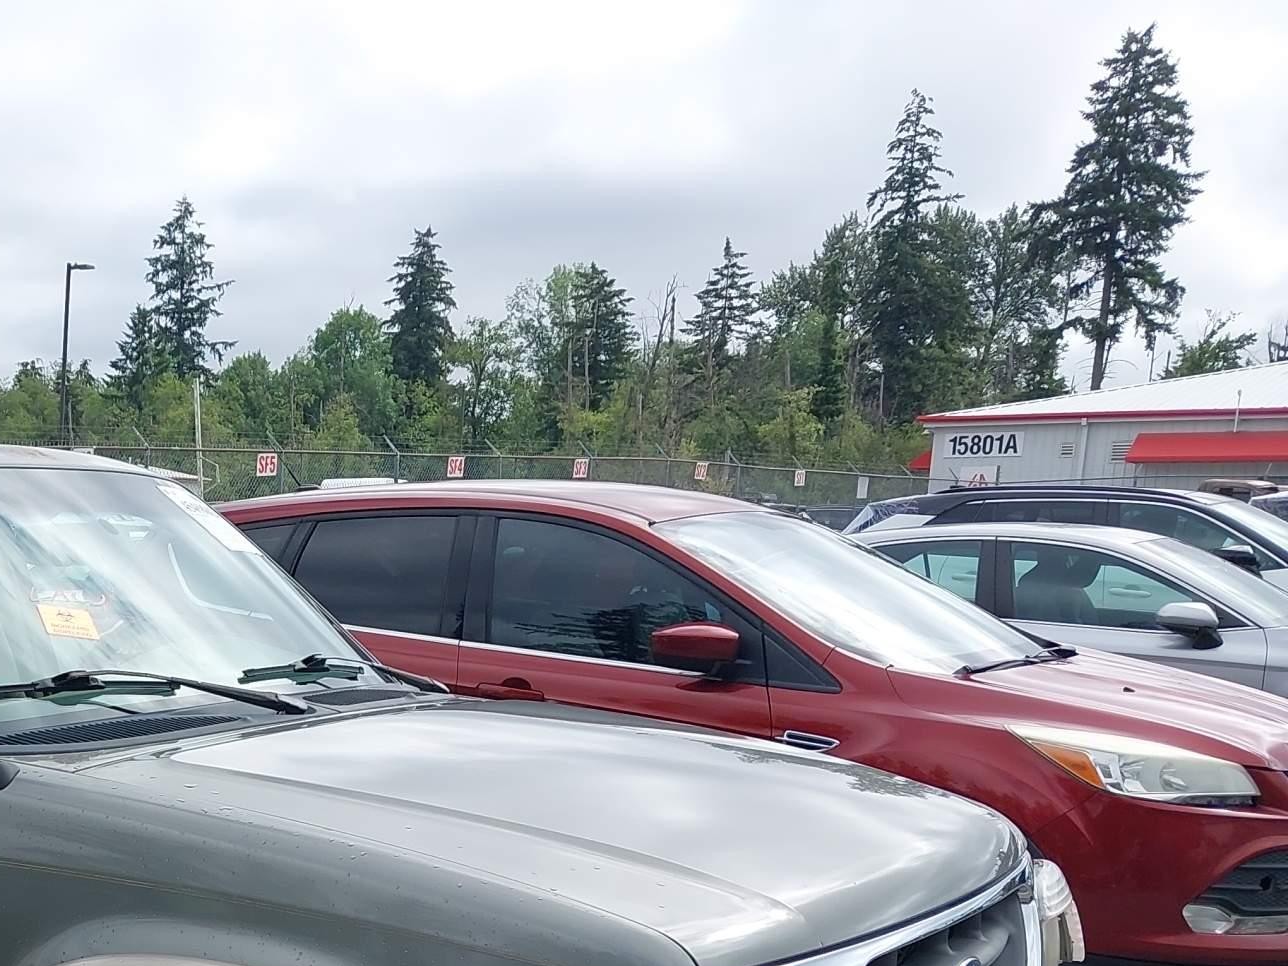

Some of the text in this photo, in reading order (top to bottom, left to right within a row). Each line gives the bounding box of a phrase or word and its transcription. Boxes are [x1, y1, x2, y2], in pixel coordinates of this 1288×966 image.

[948, 433, 1018, 456] 15801A
[258, 455, 277, 474] SF5
[448, 458, 463, 475] SF4
[573, 458, 588, 476] SF3
[695, 463, 707, 479] SF2
